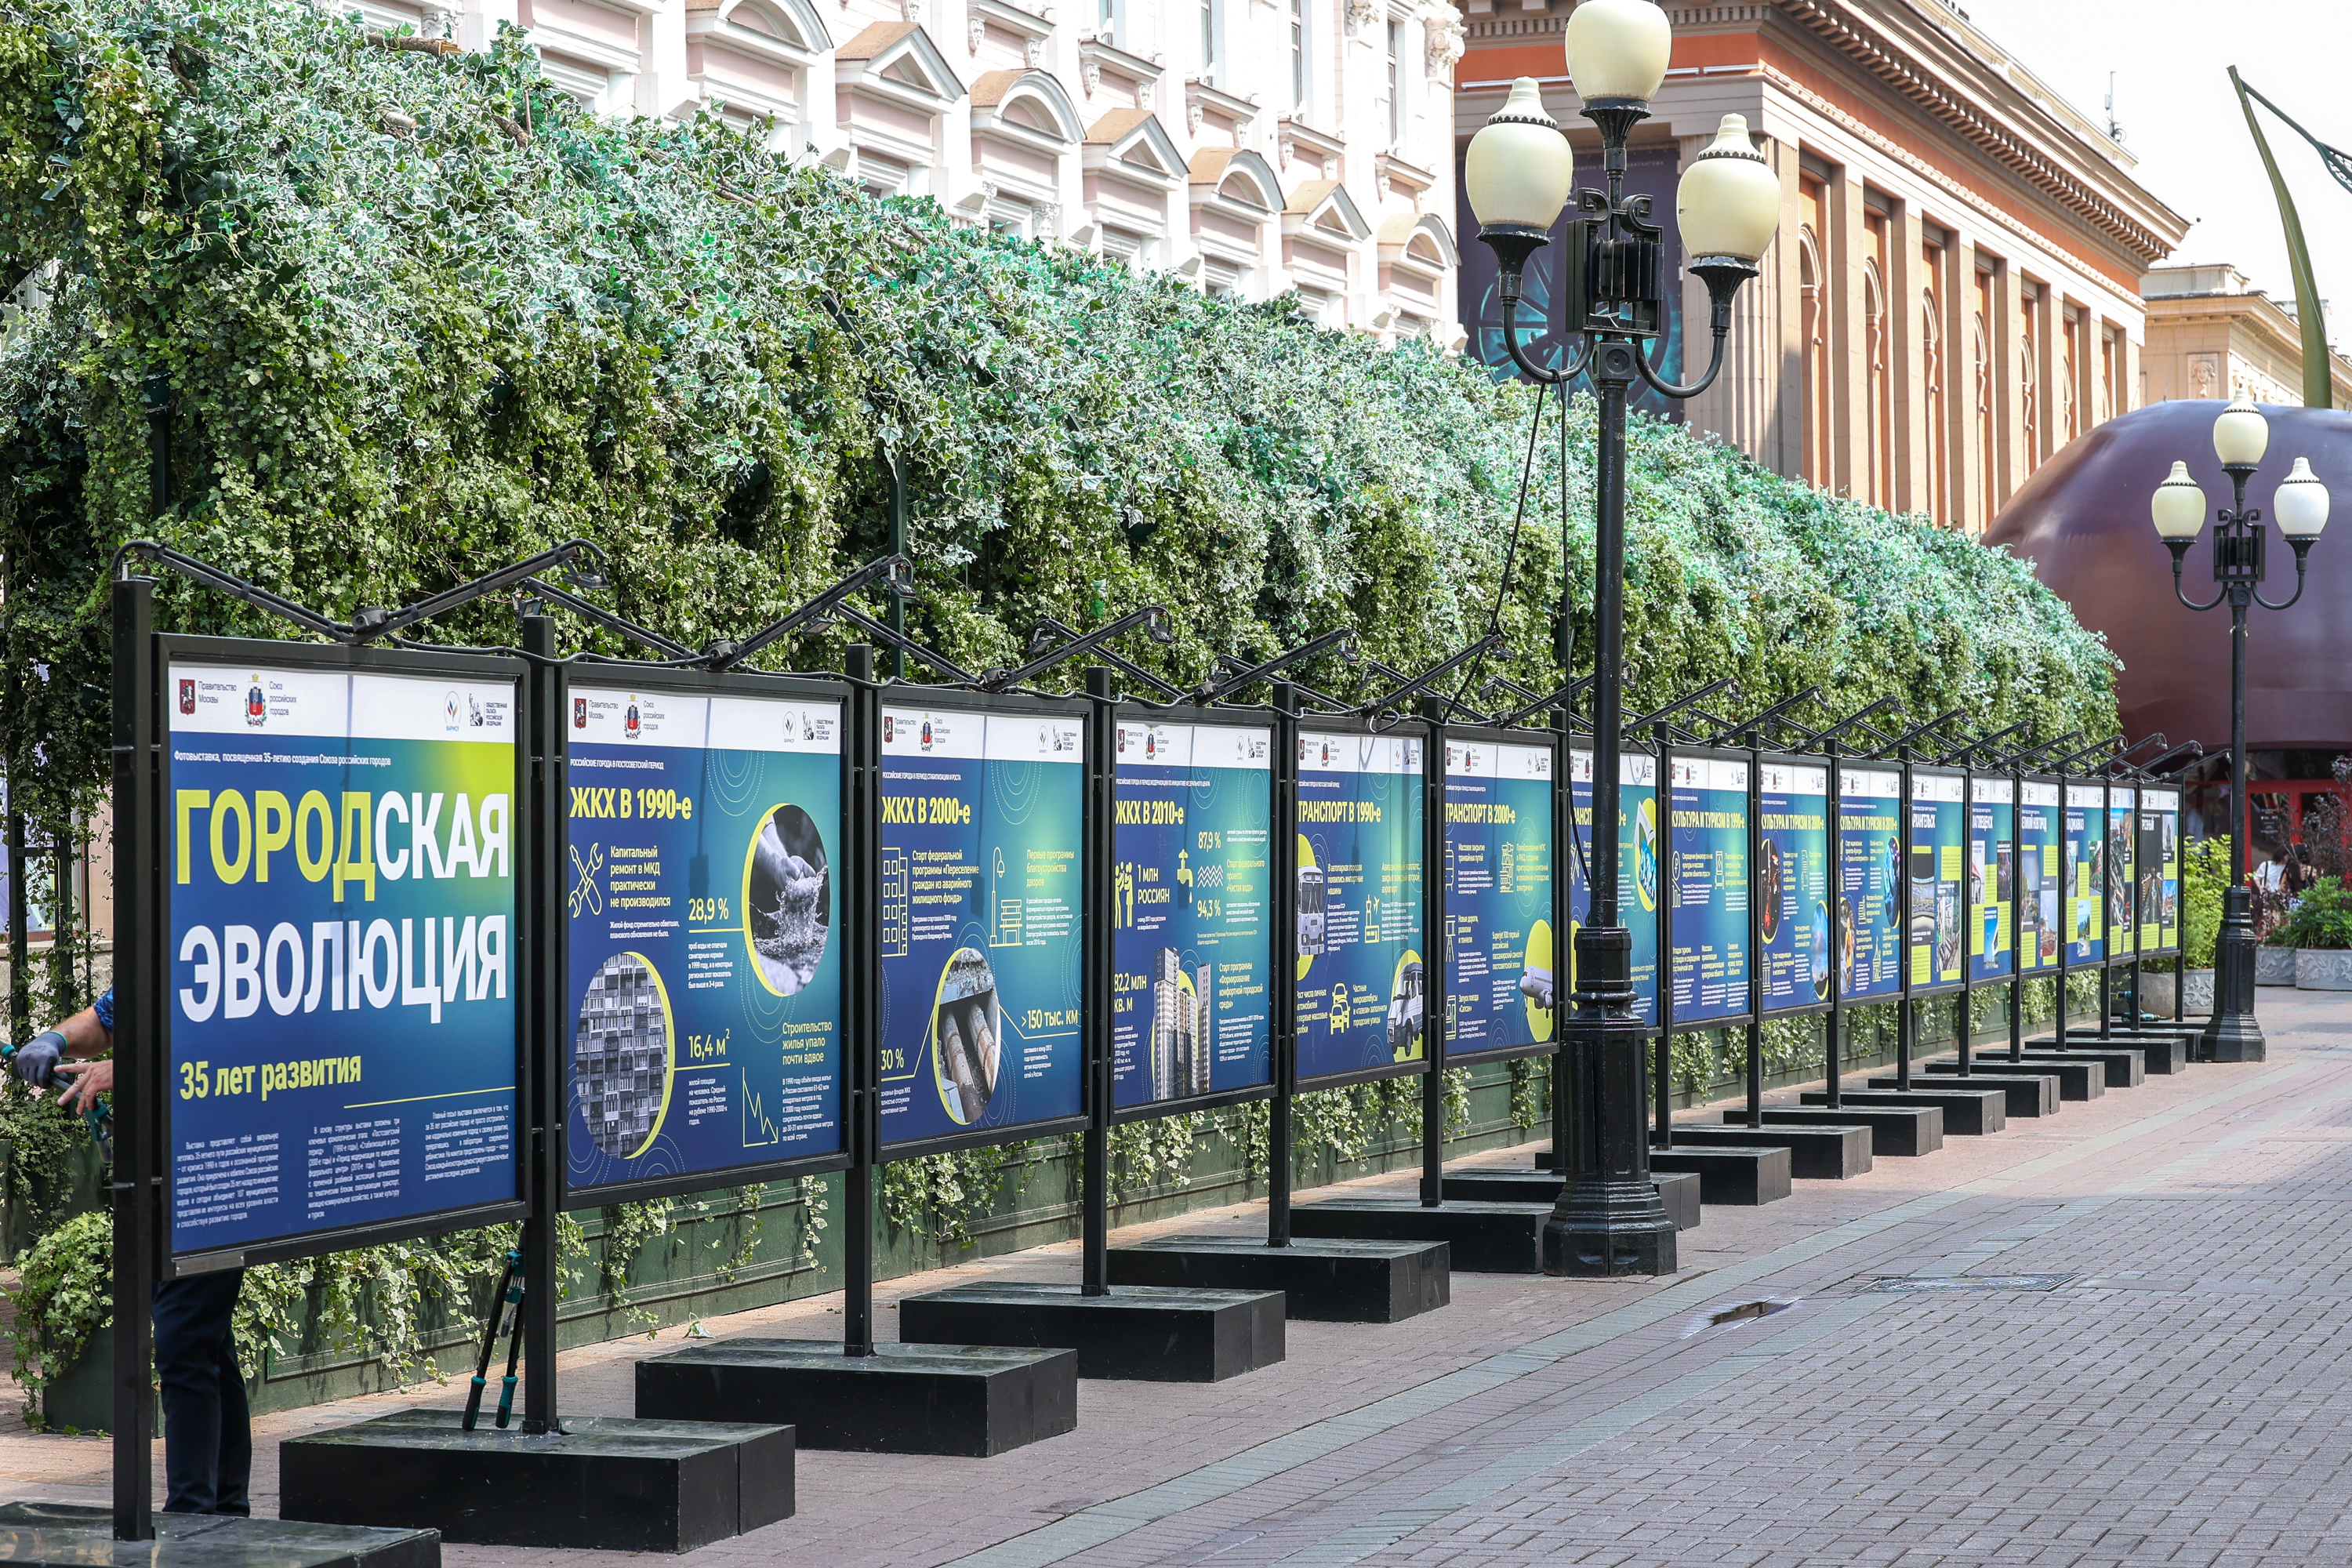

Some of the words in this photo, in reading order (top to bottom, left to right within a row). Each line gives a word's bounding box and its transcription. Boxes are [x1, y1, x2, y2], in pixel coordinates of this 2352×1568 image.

[198, 681, 237, 692] Правительство
[269, 681, 283, 690] Союз
[198, 694, 219, 703] Москвы
[269, 694, 297, 706] российских
[269, 707, 289, 717] городов
[174, 750, 221, 762] Фотовыставка,
[263, 753, 291, 763] 35-летию
[292, 755, 319, 765] создания
[319, 753, 338, 764] Союза
[338, 755, 369, 767] российских
[369, 757, 391, 767] городов
[569, 786, 616, 818] ЖКХ
[619, 788, 632, 818] В
[637, 788, 691, 820] 1990-е
[882, 797, 915, 824] ЖКХ
[918, 797, 927, 824] В
[929, 797, 971, 825] 2000-е
[1116, 800, 1142, 825] ЖКХ
[1143, 800, 1150, 825] В
[1152, 800, 1184, 825] 2010-е
[1298, 800, 1348, 822] ТРАНСПОРТ
[1348, 801, 1355, 822] В
[1356, 801, 1381, 823] 1990-е
[1445, 803, 1487, 823] ТРАНСПОРТ
[1487, 804, 1493, 823] В
[1494, 804, 1516, 825] 2000-е
[1671, 810, 1700, 828] КУЛЬТУРА
[1704, 811, 1726, 829] ТУРИЗМ
[1730, 811, 1745, 829] 1990-е
[2142, 817, 2154, 831] РОЗНЫЙ
[176, 789, 509, 902] ГОРОДСКАЯ
[1198, 831, 1214, 852] 87,9
[1214, 831, 1221, 849] %
[610, 845, 658, 858] Капитальный
[912, 850, 927, 863] Старт
[927, 849, 963, 863] федеральной
[1027, 849, 1046, 862] Первые
[1047, 851, 1075, 862] программы
[610, 864, 637, 877] ремонт
[644, 862, 660, 877] МКД
[912, 866, 942, 877] программы
[942, 864, 979, 877] «Переселение
[1026, 862, 1067, 875] благоустройства
[1226, 858, 1238, 869] Старт
[1238, 859, 1265, 869] федерального
[1137, 864, 1142, 883] 1
[1226, 872, 1243, 882] проекта
[610, 880, 655, 894] практически
[912, 880, 935, 892] граждан
[935, 880, 942, 889] из
[942, 877, 972, 891] аварийного
[1026, 878, 1044, 888] дворов
[610, 898, 619, 908] не
[620, 896, 671, 910] производился
[912, 895, 943, 906] жилищного
[943, 891, 963, 906] фонда»
[688, 898, 715, 925] 28,9
[717, 898, 729, 920] %
[1197, 899, 1214, 920] 94,3
[1214, 899, 1221, 916] %
[623, 921, 633, 930] фонд
[179, 915, 506, 1024] ЭВОЛЮЦИЯ
[1219, 963, 1230, 974] Старт
[1230, 963, 1253, 973] программы
[1114, 972, 1130, 995] 82,2
[1218, 985, 1243, 998] комфортной
[1243, 982, 1263, 996] городской
[1352, 984, 1367, 993] Частные
[1352, 993, 1378, 1005] микроавтобусы
[1044, 1010, 1064, 1028] тыс.
[782, 1022, 833, 1036] Строительство
[688, 1034, 713, 1062] 16,4
[782, 1038, 804, 1051] жилья
[804, 1037, 826, 1051] упало
[782, 1054, 803, 1065] почти
[804, 1052, 824, 1065] вдвое
[880, 1050, 893, 1071] 30
[895, 1047, 905, 1069] %
[180, 1061, 209, 1100] 35
[215, 1065, 256, 1098] лет
[262, 1055, 361, 1102] развития
